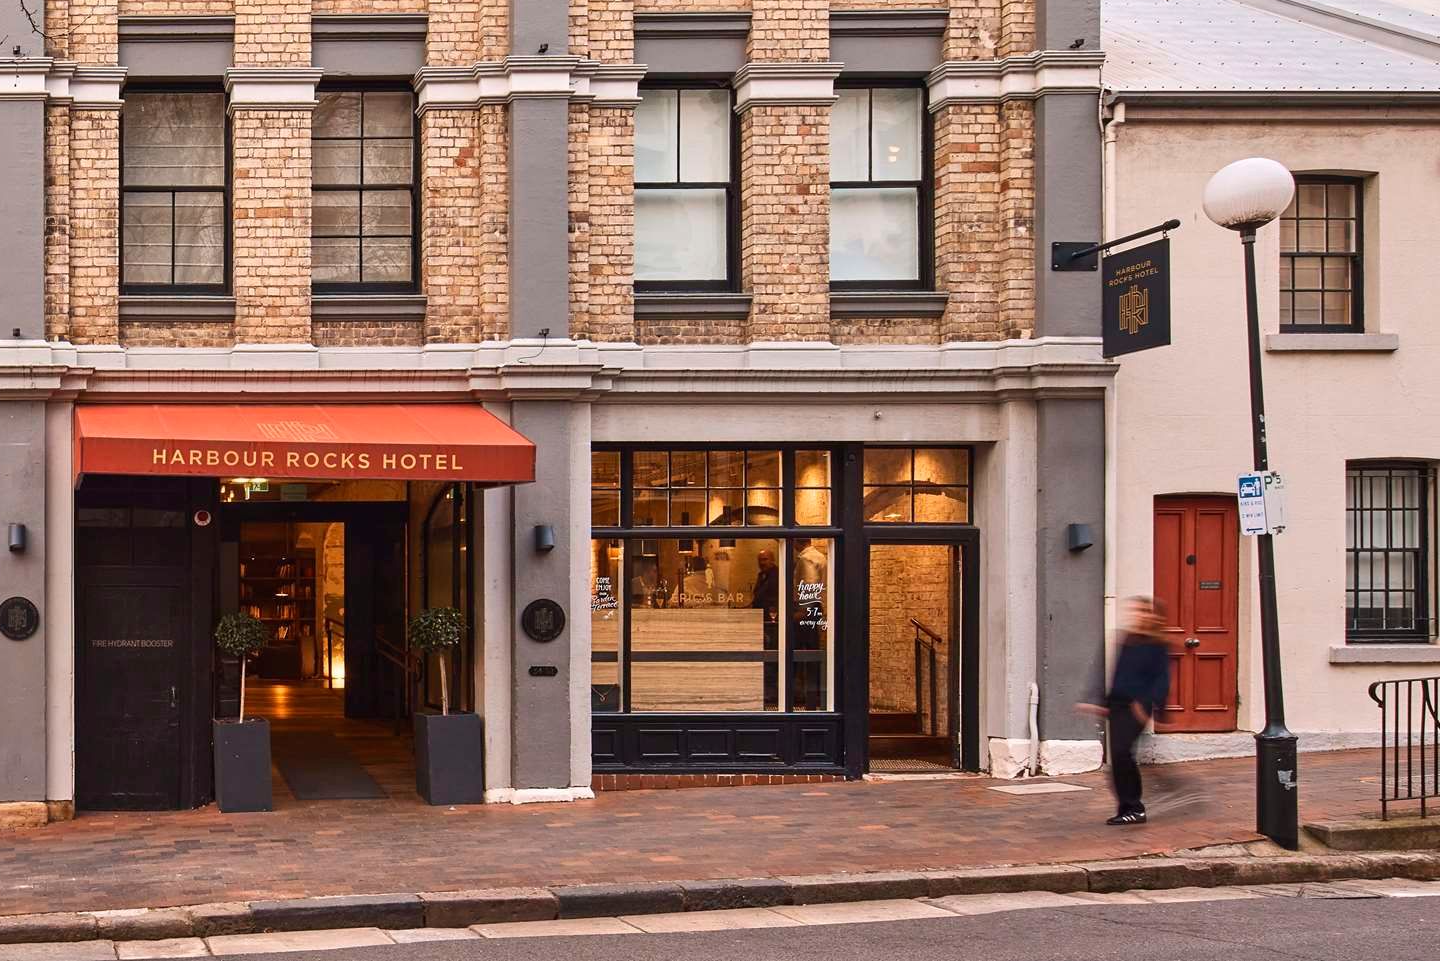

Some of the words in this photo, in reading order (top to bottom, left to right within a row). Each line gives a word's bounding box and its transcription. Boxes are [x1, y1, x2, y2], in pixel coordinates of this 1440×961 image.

[1115, 259, 1152, 277] HARBOUR
[1108, 273, 1133, 287] ROCKS
[1134, 267, 1159, 281] HOTEL
[152, 448, 274, 467] HARBOUR
[286, 451, 371, 469] ROCKS
[382, 453, 464, 470] HOTEL
[797, 579, 825, 593] happy
[718, 592, 744, 603] BAR
[797, 590, 822, 600] hour
[799, 619, 816, 630] every
[91, 639, 107, 648] FIRE
[107, 639, 140, 648] HYDRANT
[141, 639, 174, 648] BOOSTER
